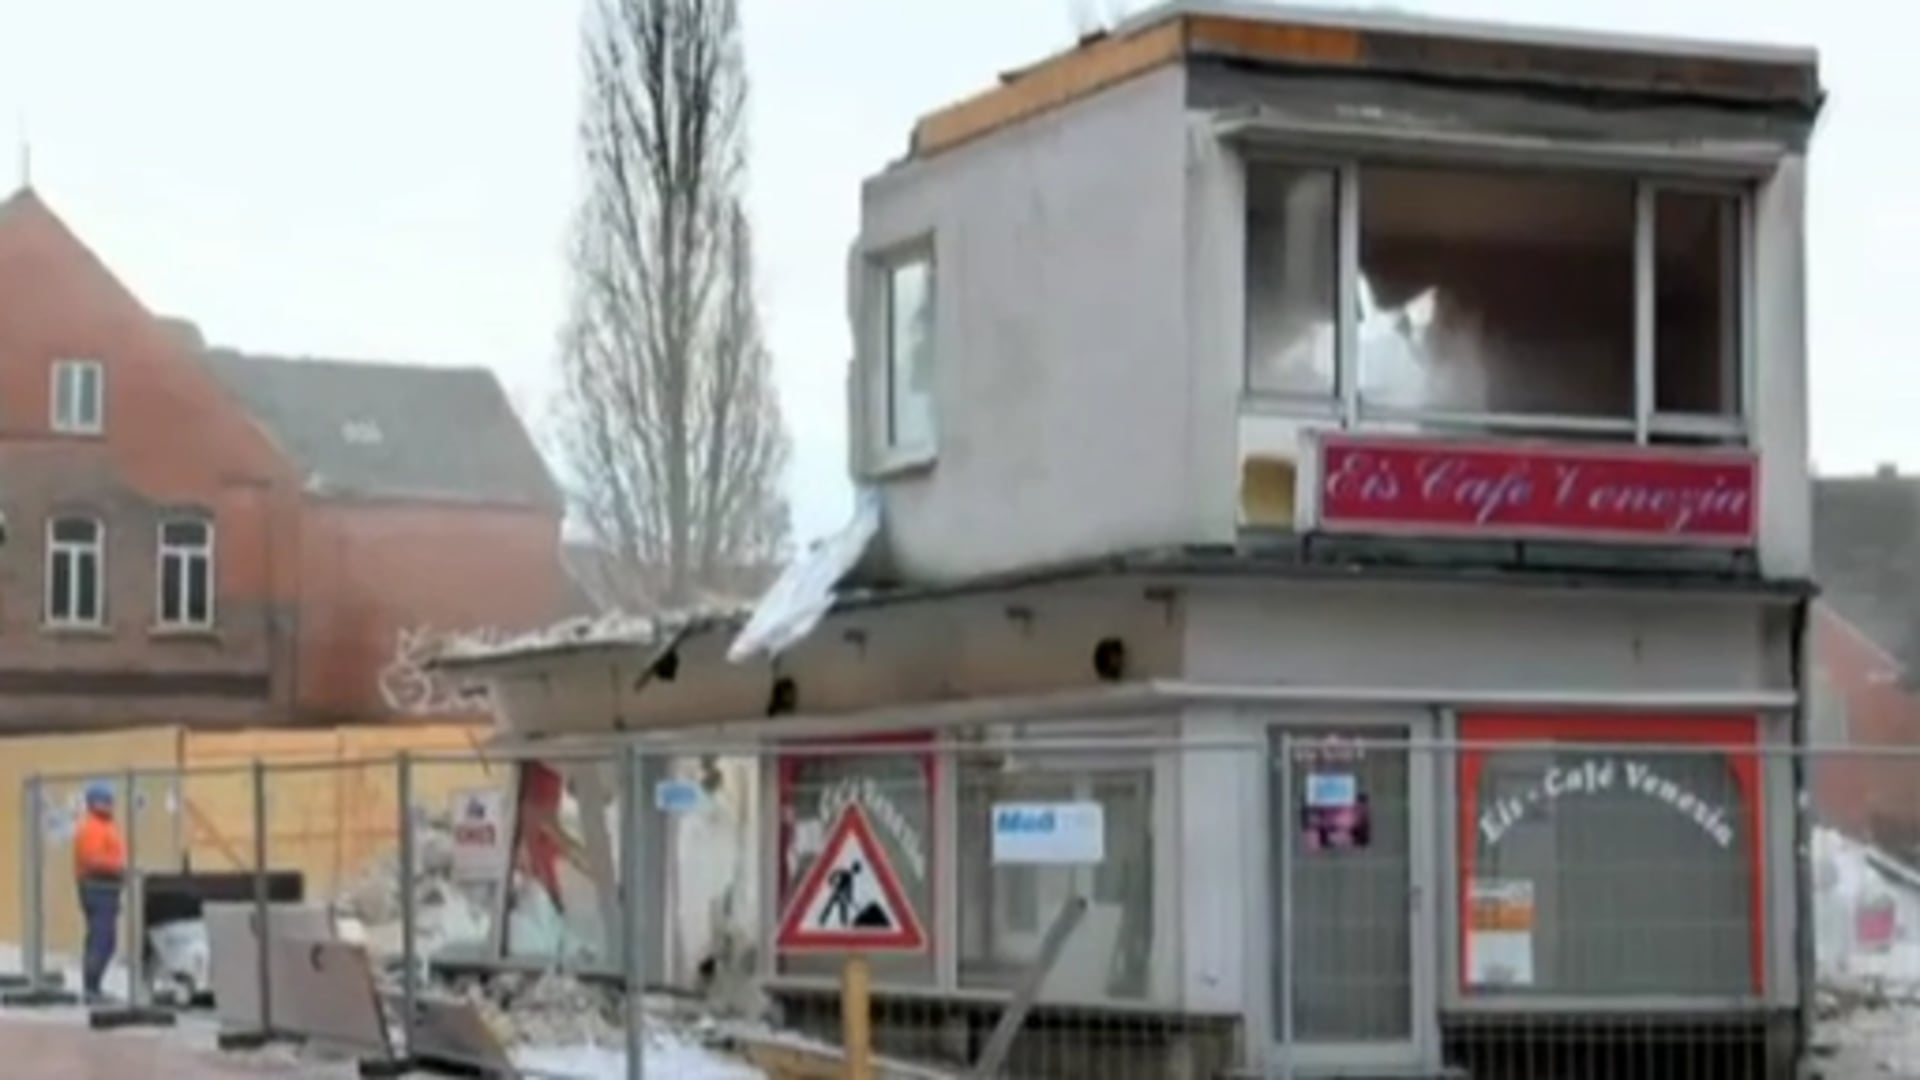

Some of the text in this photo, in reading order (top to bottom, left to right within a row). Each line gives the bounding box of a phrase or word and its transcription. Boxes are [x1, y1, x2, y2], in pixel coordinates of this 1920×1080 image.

[1326, 455, 1399, 501] Eis
[1554, 463, 1748, 532] Venezia
[1480, 798, 1524, 844] Eis
[1624, 760, 1733, 848] Venezia
